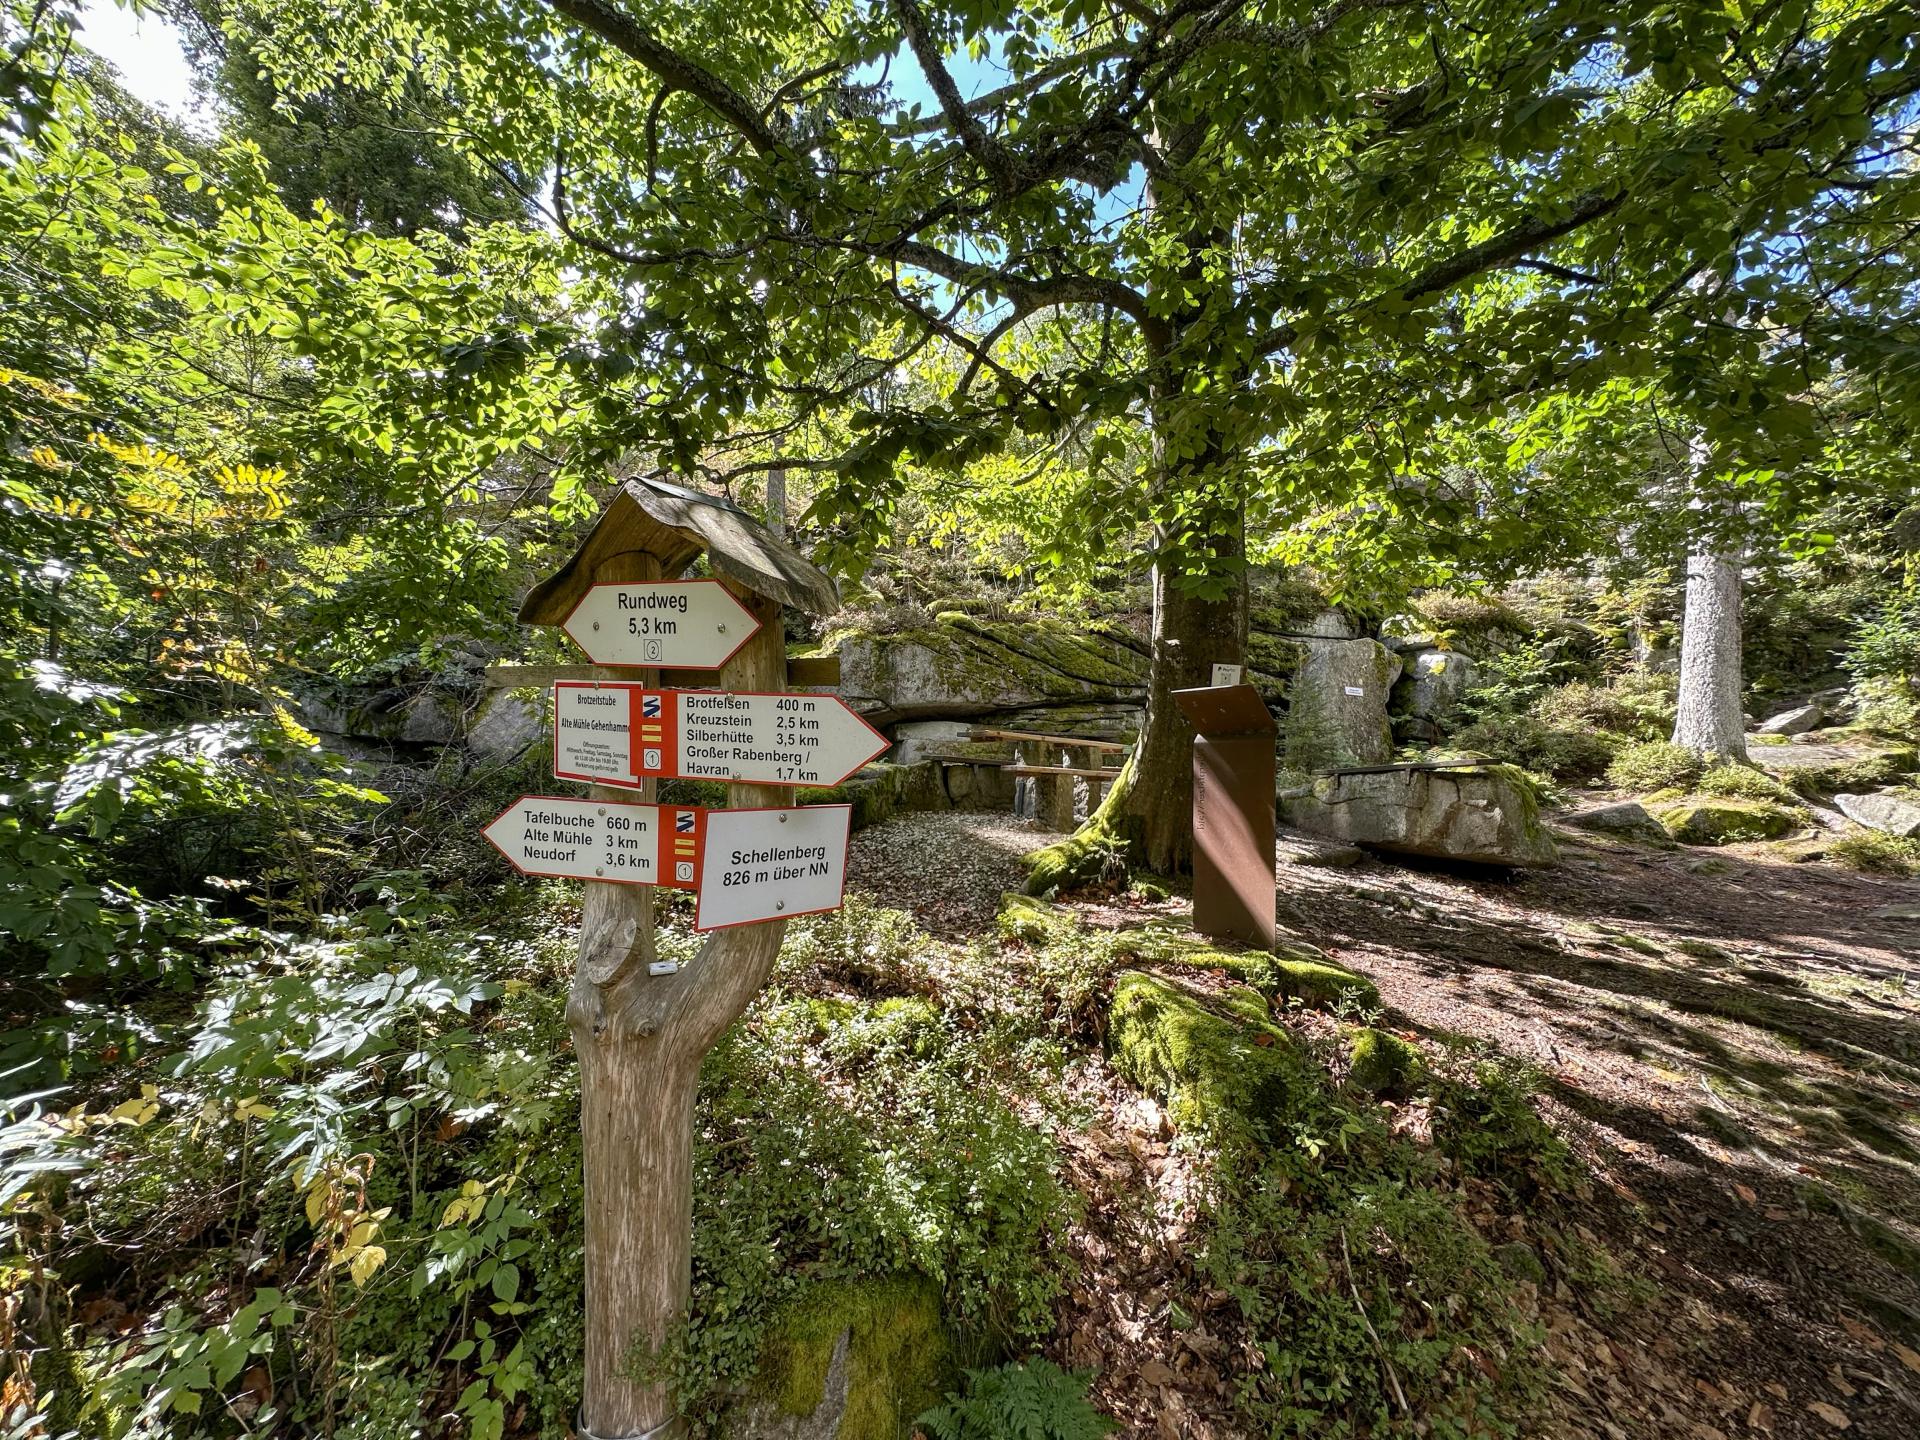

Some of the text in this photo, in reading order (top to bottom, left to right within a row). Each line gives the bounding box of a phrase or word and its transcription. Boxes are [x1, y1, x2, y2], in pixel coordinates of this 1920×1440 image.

[618, 592, 688, 613] Rundweg
[629, 617, 677, 638] 5,3 km
[650, 646, 656, 655] 2
[577, 694, 616, 706] Brotzeitstube
[687, 697, 815, 711] Brotfelsen 400 m
[561, 717, 572, 728] Alte
[573, 718, 590, 730] Mühle
[687, 713, 819, 730] Kreuzstein 2,5 km
[687, 730, 819, 747] Silberhütte 3,5 km
[613, 752, 628, 760] Sonntag
[687, 746, 729, 759] Großer
[733, 748, 801, 765] Rabenberg
[687, 762, 818, 782] Havran 1,7 km
[524, 810, 647, 832] Tafelbuche 660 m
[524, 828, 638, 849] Alte Mühle 3 km
[524, 845, 650, 868] Neudorf 3,6 km
[731, 846, 825, 865] Schellenberg
[723, 862, 829, 886] 826 m über NN
